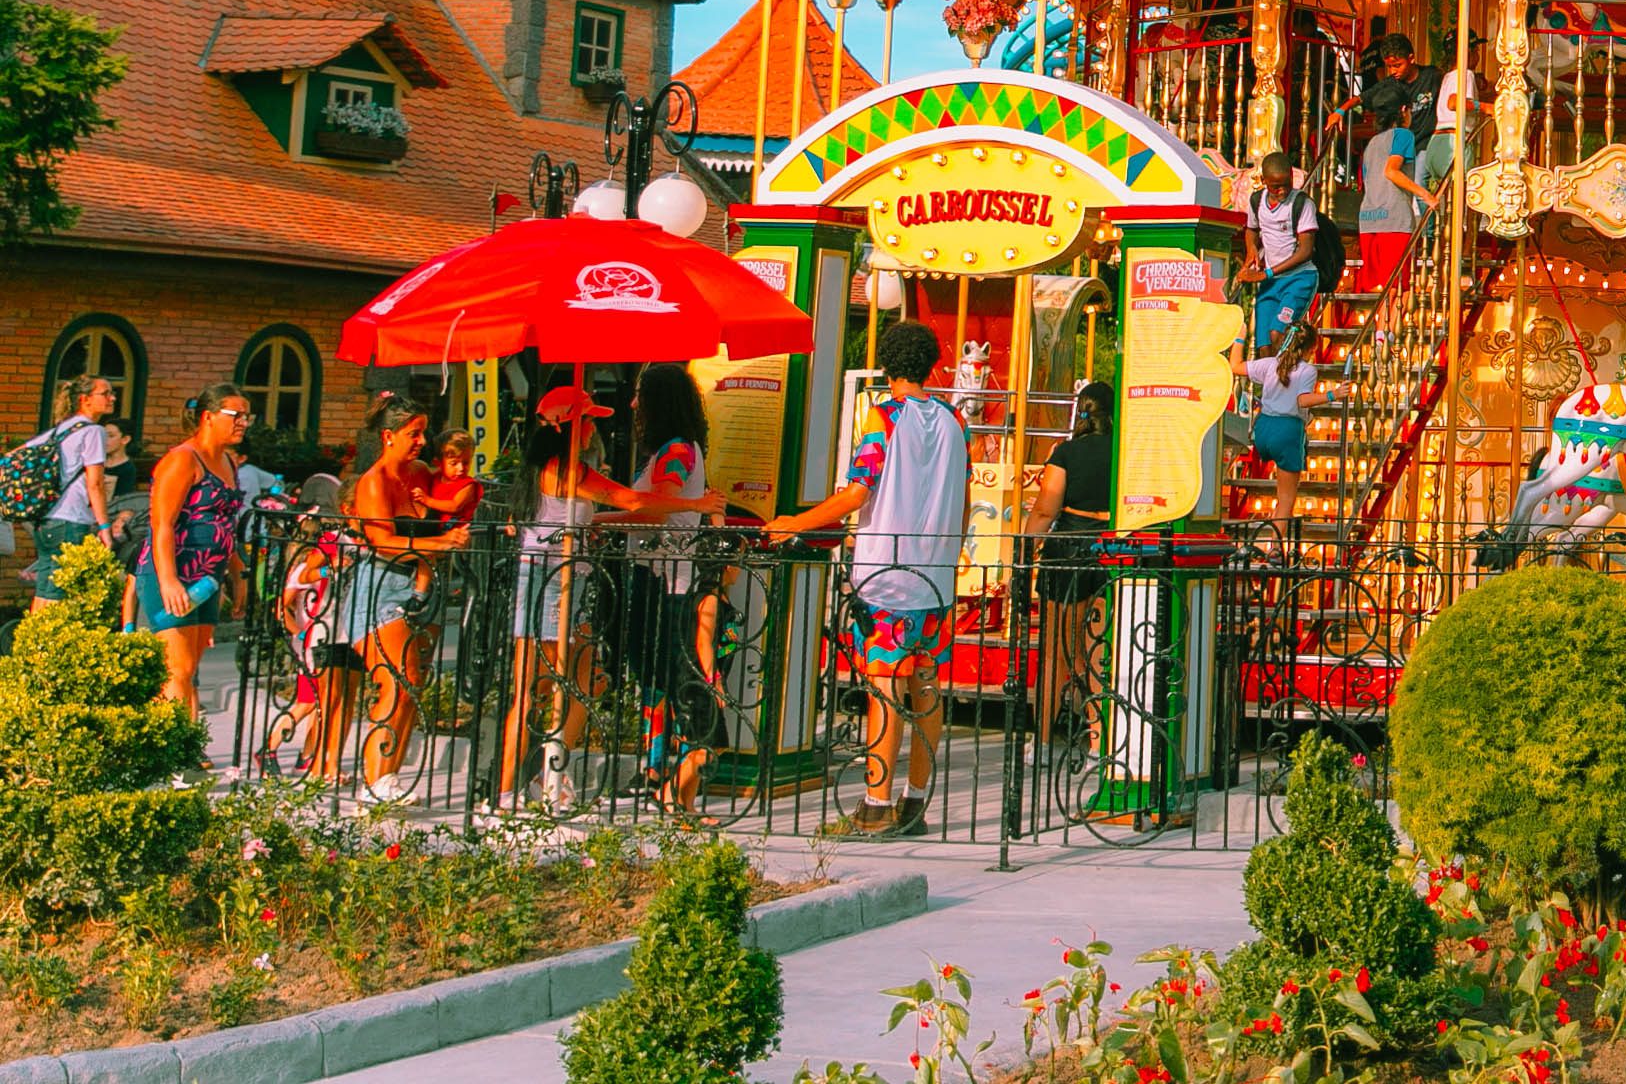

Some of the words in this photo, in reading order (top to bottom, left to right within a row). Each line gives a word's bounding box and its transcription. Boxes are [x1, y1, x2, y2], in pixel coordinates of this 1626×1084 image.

[897, 189, 1053, 228] CARROUSSEL
[1136, 262, 1206, 283] CARROSSEL
[1146, 277, 1206, 294] VENEZIANO
